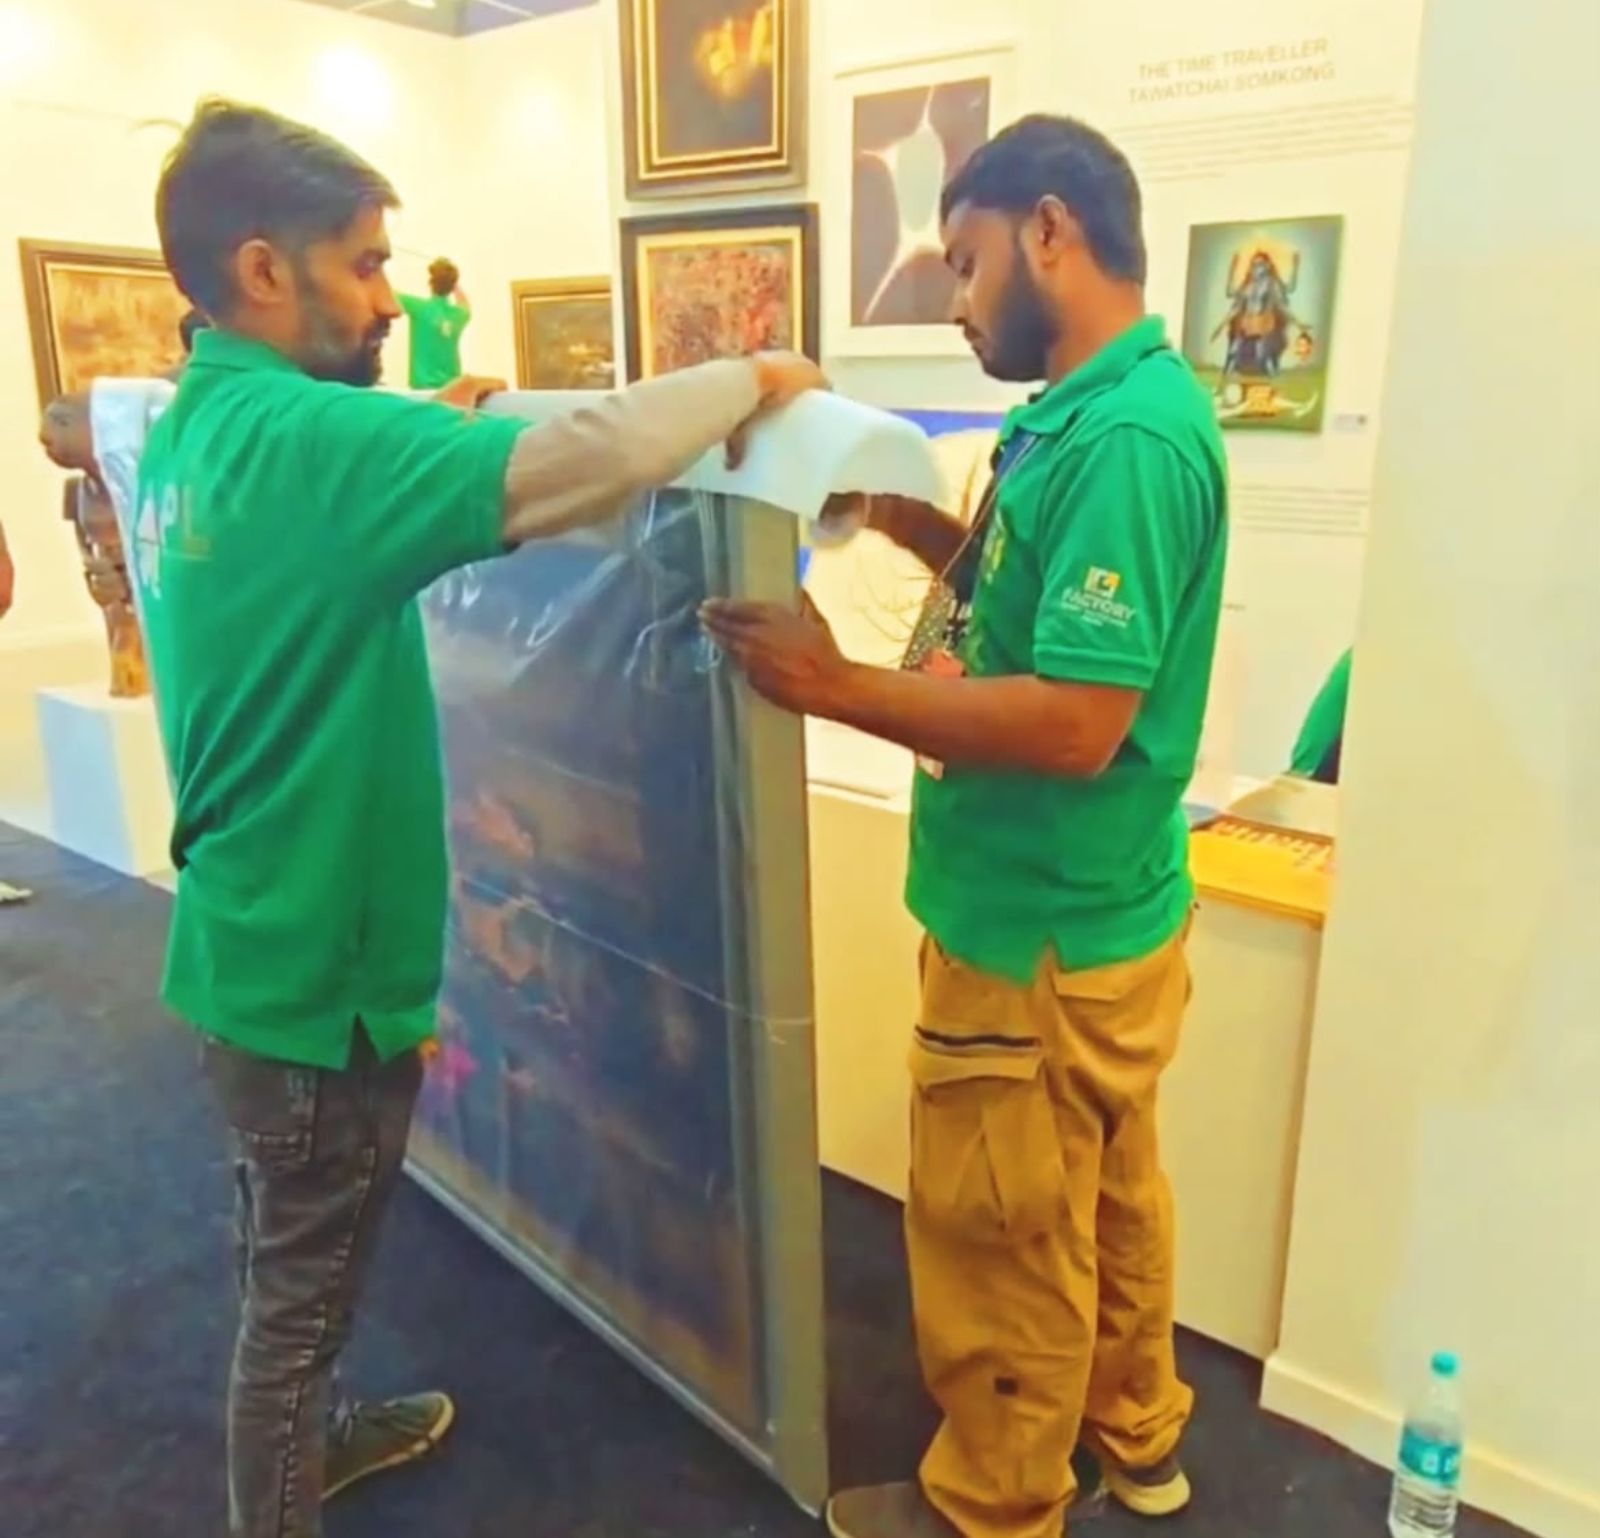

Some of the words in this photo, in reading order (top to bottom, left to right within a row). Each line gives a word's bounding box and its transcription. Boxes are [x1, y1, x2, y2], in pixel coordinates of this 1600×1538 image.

[1138, 63, 1169, 80] THE
[1177, 55, 1215, 75] TIME
[1222, 37, 1328, 67] TRAVELLER
[1128, 78, 1229, 103] TAWATCHAI
[1234, 62, 1335, 92] SOMKONG
[1061, 587, 1136, 620] FACTORY
